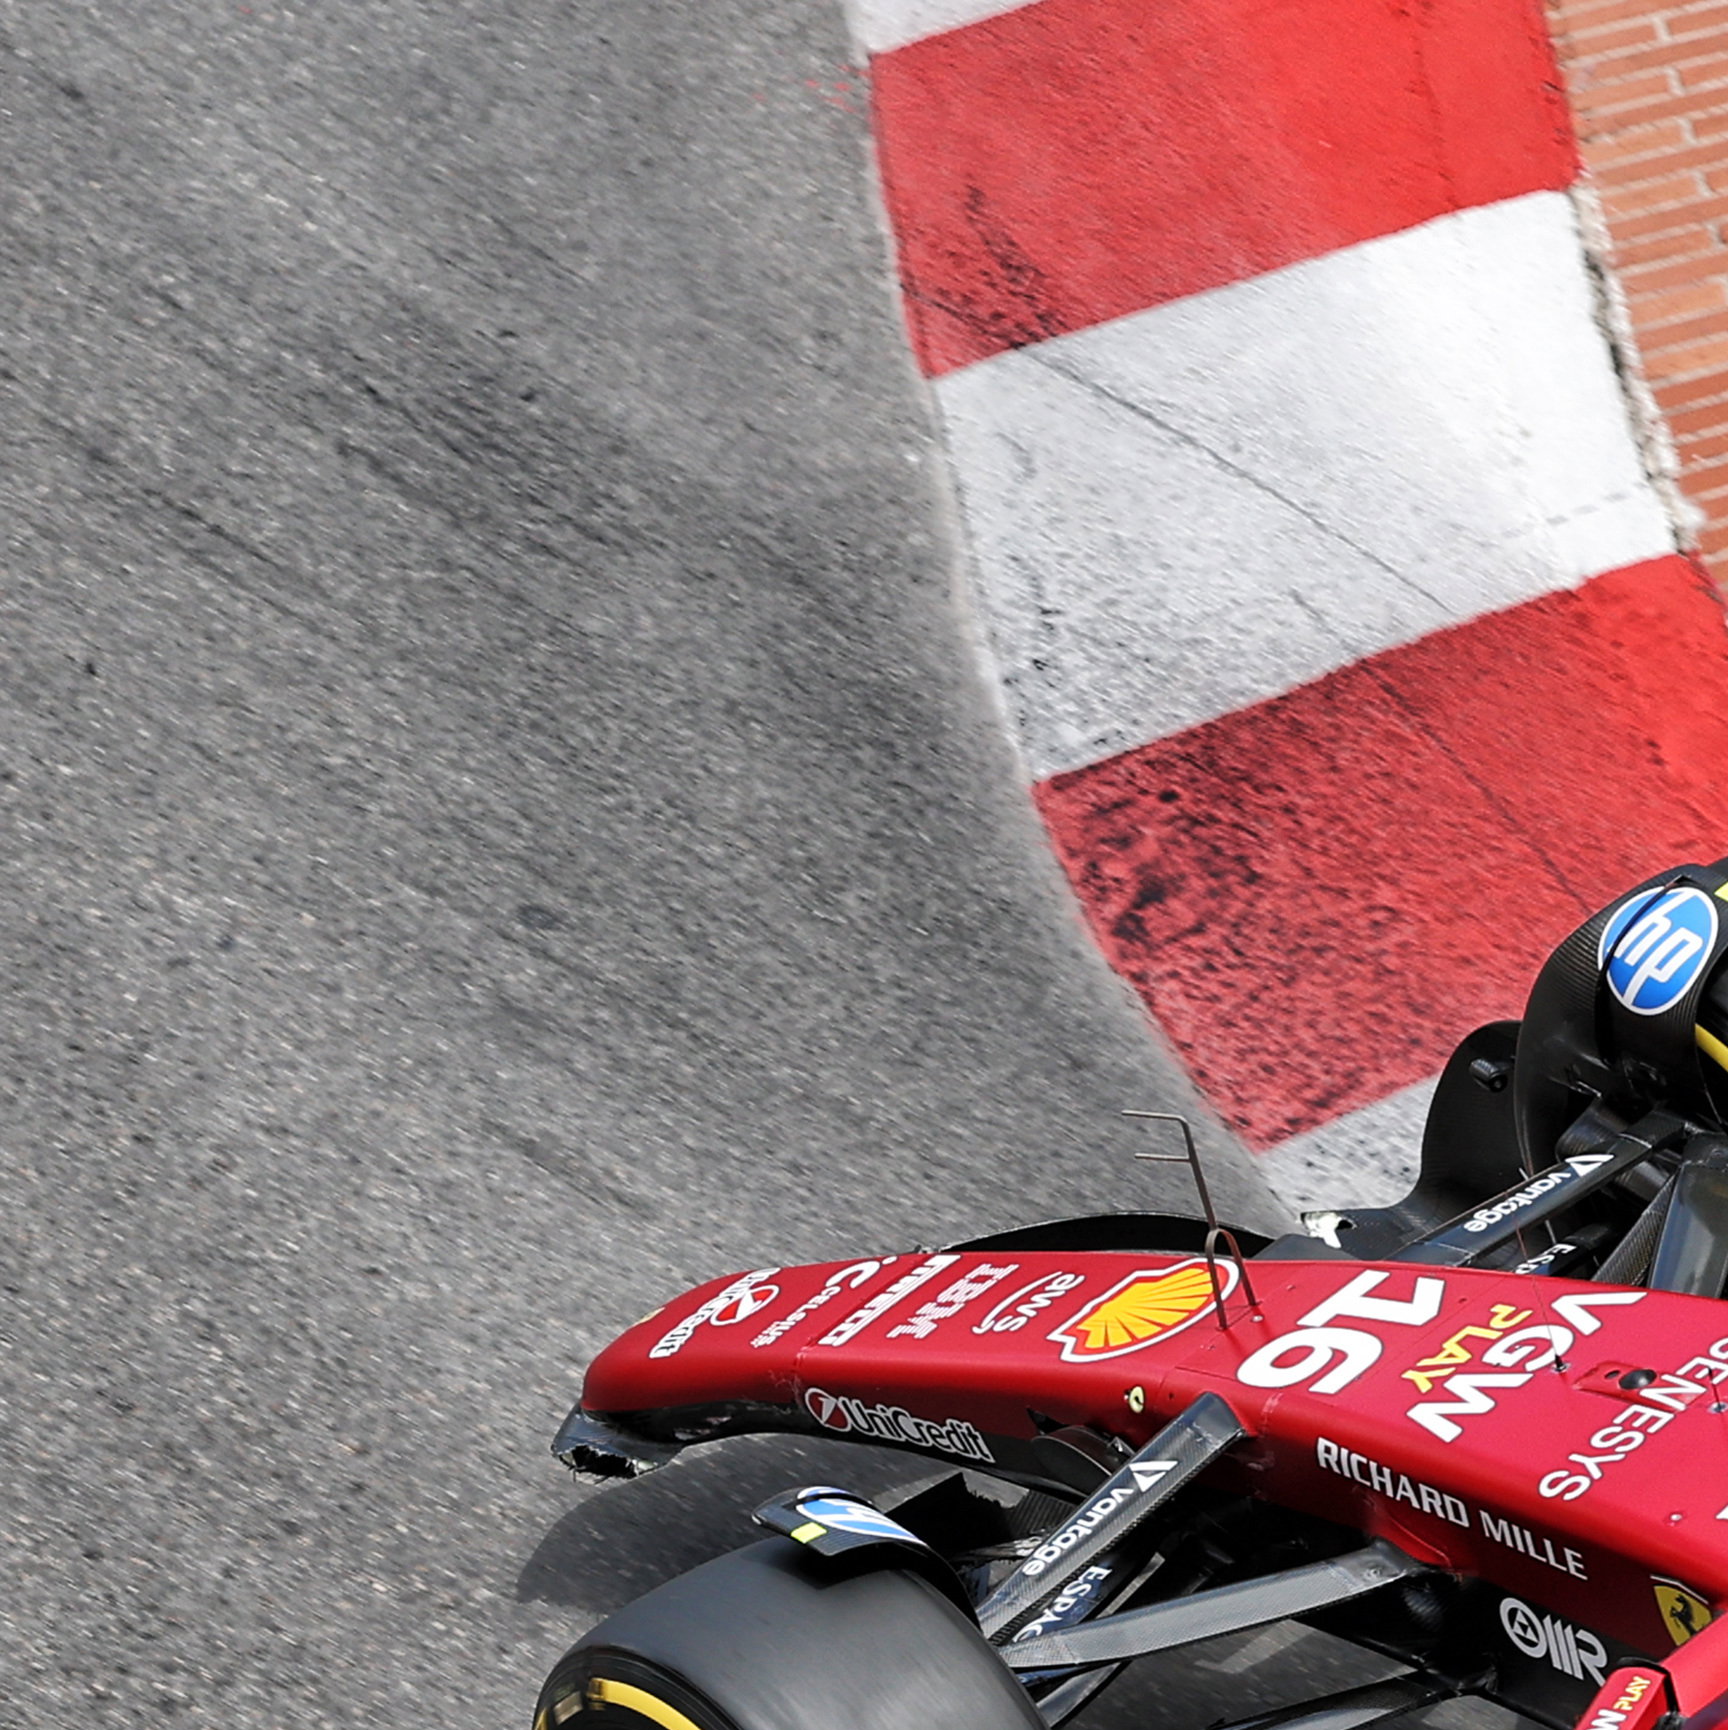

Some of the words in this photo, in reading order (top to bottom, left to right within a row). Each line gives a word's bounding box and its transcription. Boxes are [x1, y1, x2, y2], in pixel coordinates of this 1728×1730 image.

[1606, 890, 1706, 1010] hp
[1464, 1172, 1571, 1232] vantage
[818, 1254, 961, 1346] PIRELLI
[887, 1264, 1019, 1338] IBM
[993, 1274, 1085, 1332] aws
[1236, 1270, 1445, 1394] 16
[1401, 1305, 1531, 1394] PLAY
[1406, 1291, 1648, 1444] VGW
[838, 1397, 996, 1463] UniCredit
[1021, 1486, 1135, 1576] vantage
[1317, 1437, 1469, 1530] RICHARD
[1482, 1513, 1588, 1582] MILLE
[1613, 1676, 1650, 1711] PLAY
